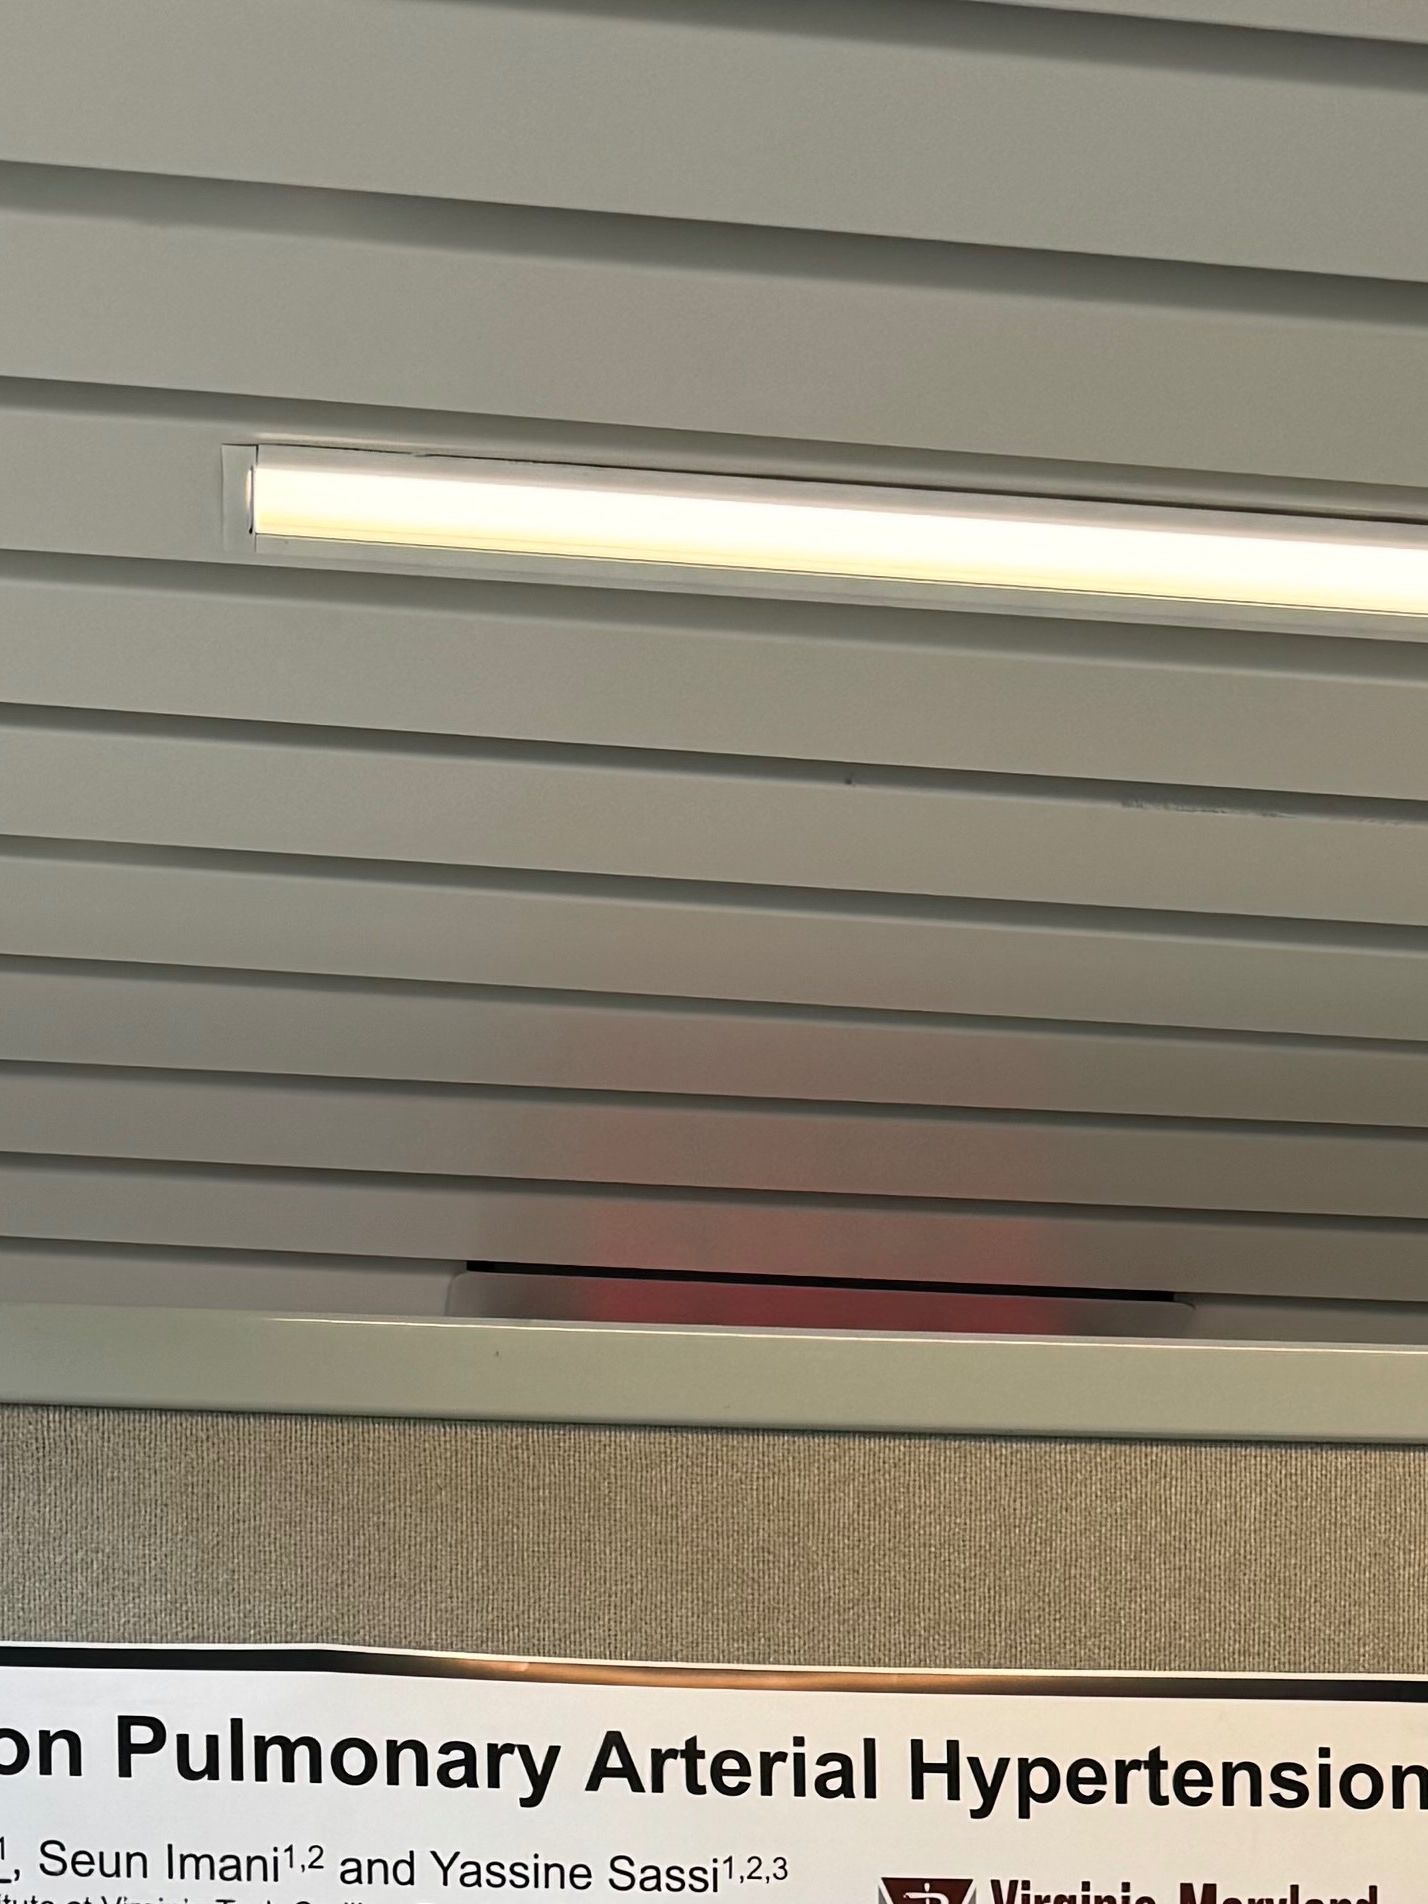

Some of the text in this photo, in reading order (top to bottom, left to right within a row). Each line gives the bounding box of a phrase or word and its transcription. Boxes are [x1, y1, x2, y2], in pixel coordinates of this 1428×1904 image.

[117, 1715, 562, 1809] Pulmonary
[584, 1730, 877, 1800] Arterial
[39, 1839, 148, 1879] Seun
[339, 1850, 415, 1886] and
[429, 1850, 593, 1891] Yassine
